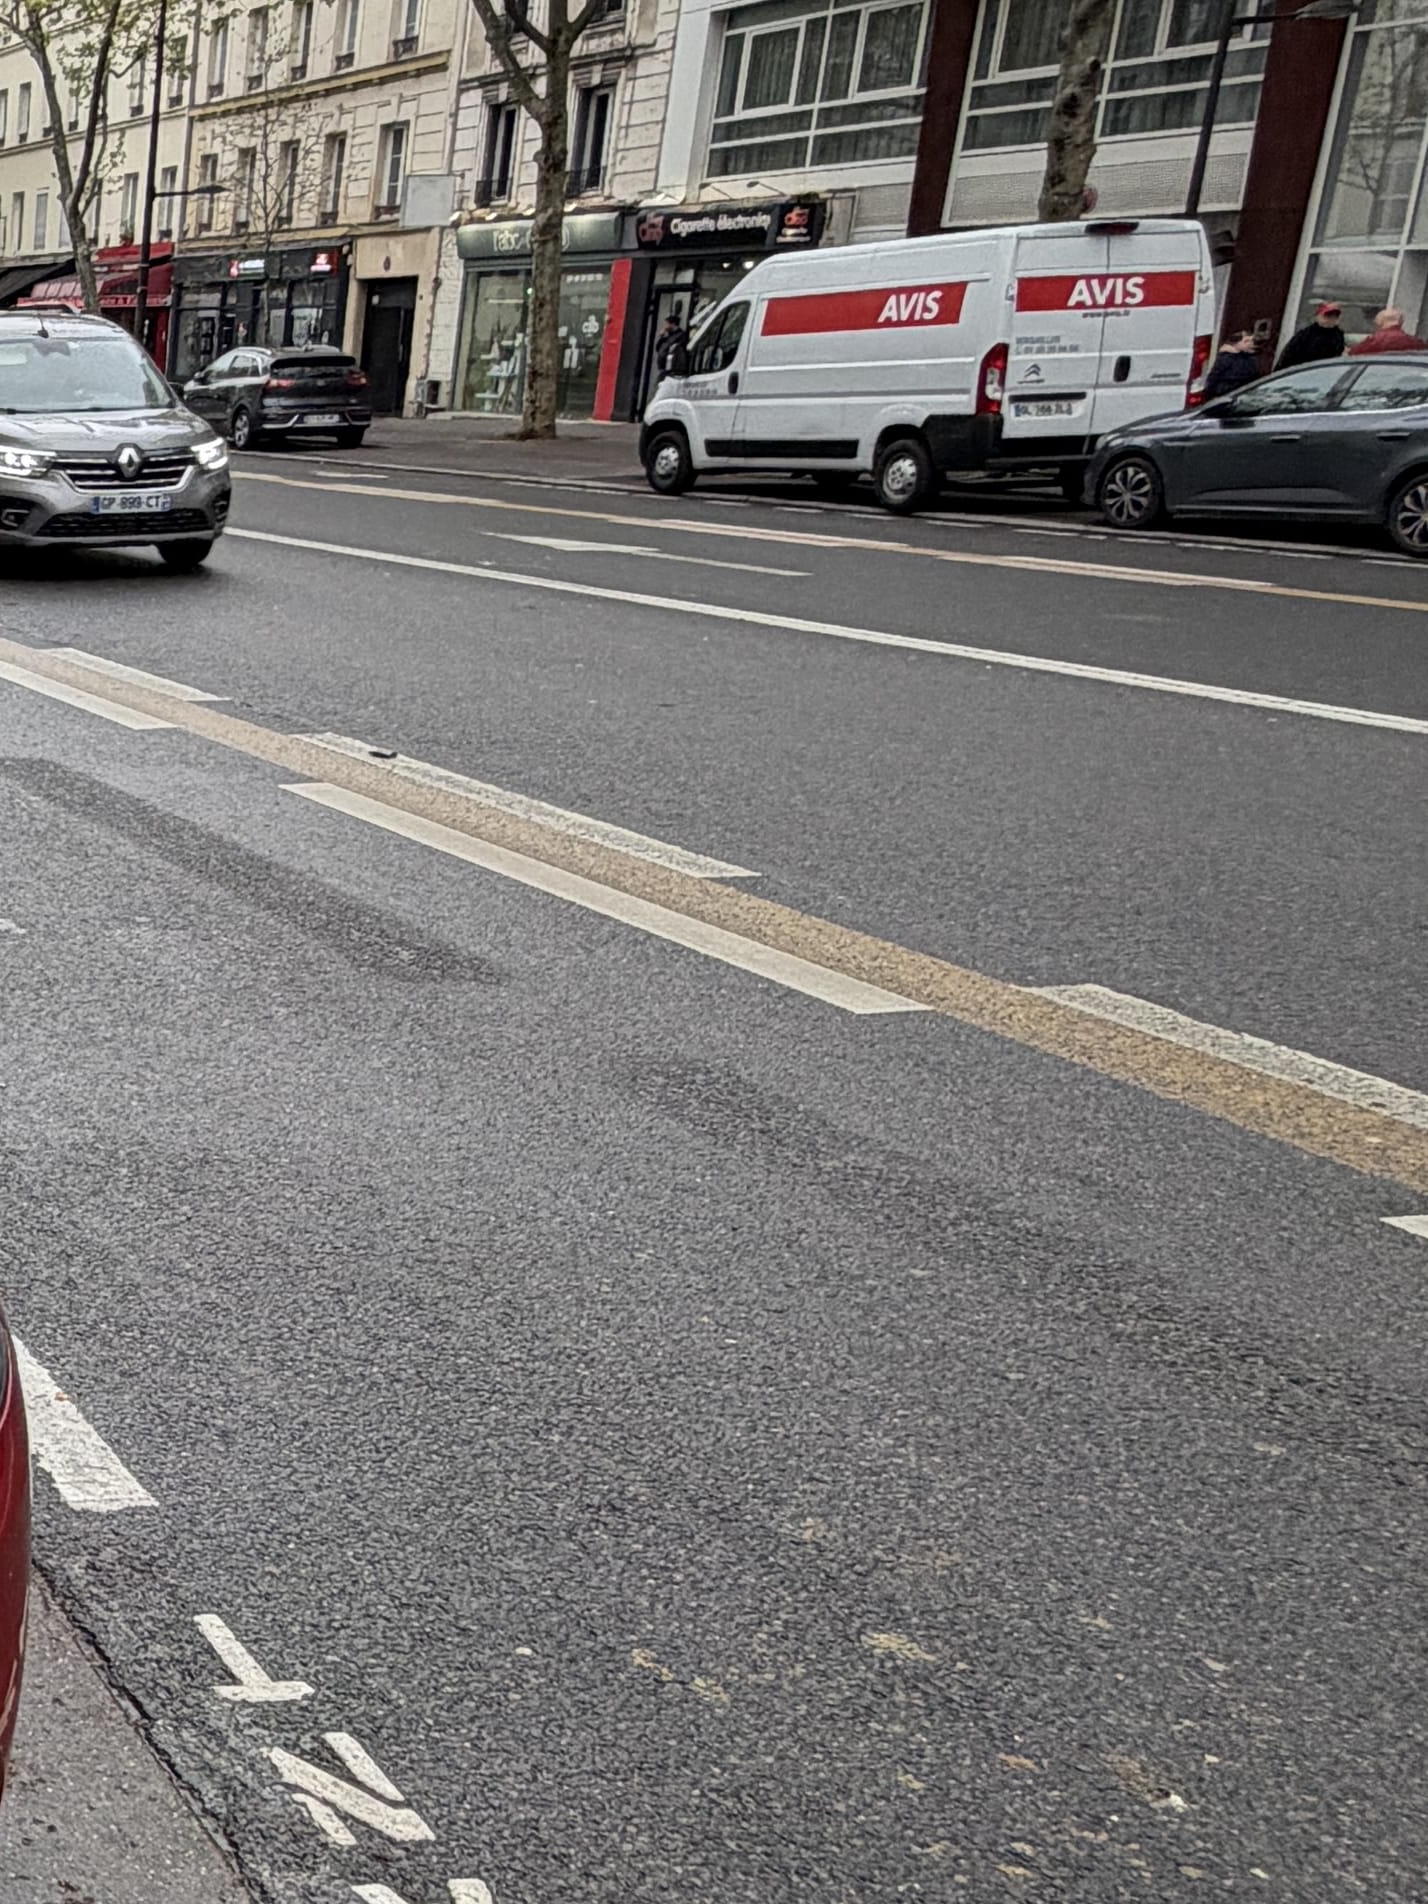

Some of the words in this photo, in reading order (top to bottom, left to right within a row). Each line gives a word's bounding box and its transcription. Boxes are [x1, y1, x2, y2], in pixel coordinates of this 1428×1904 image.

[670, 218, 715, 237] Cigarette
[877, 290, 943, 323] AVIS
[1066, 276, 1145, 307] AVIS
